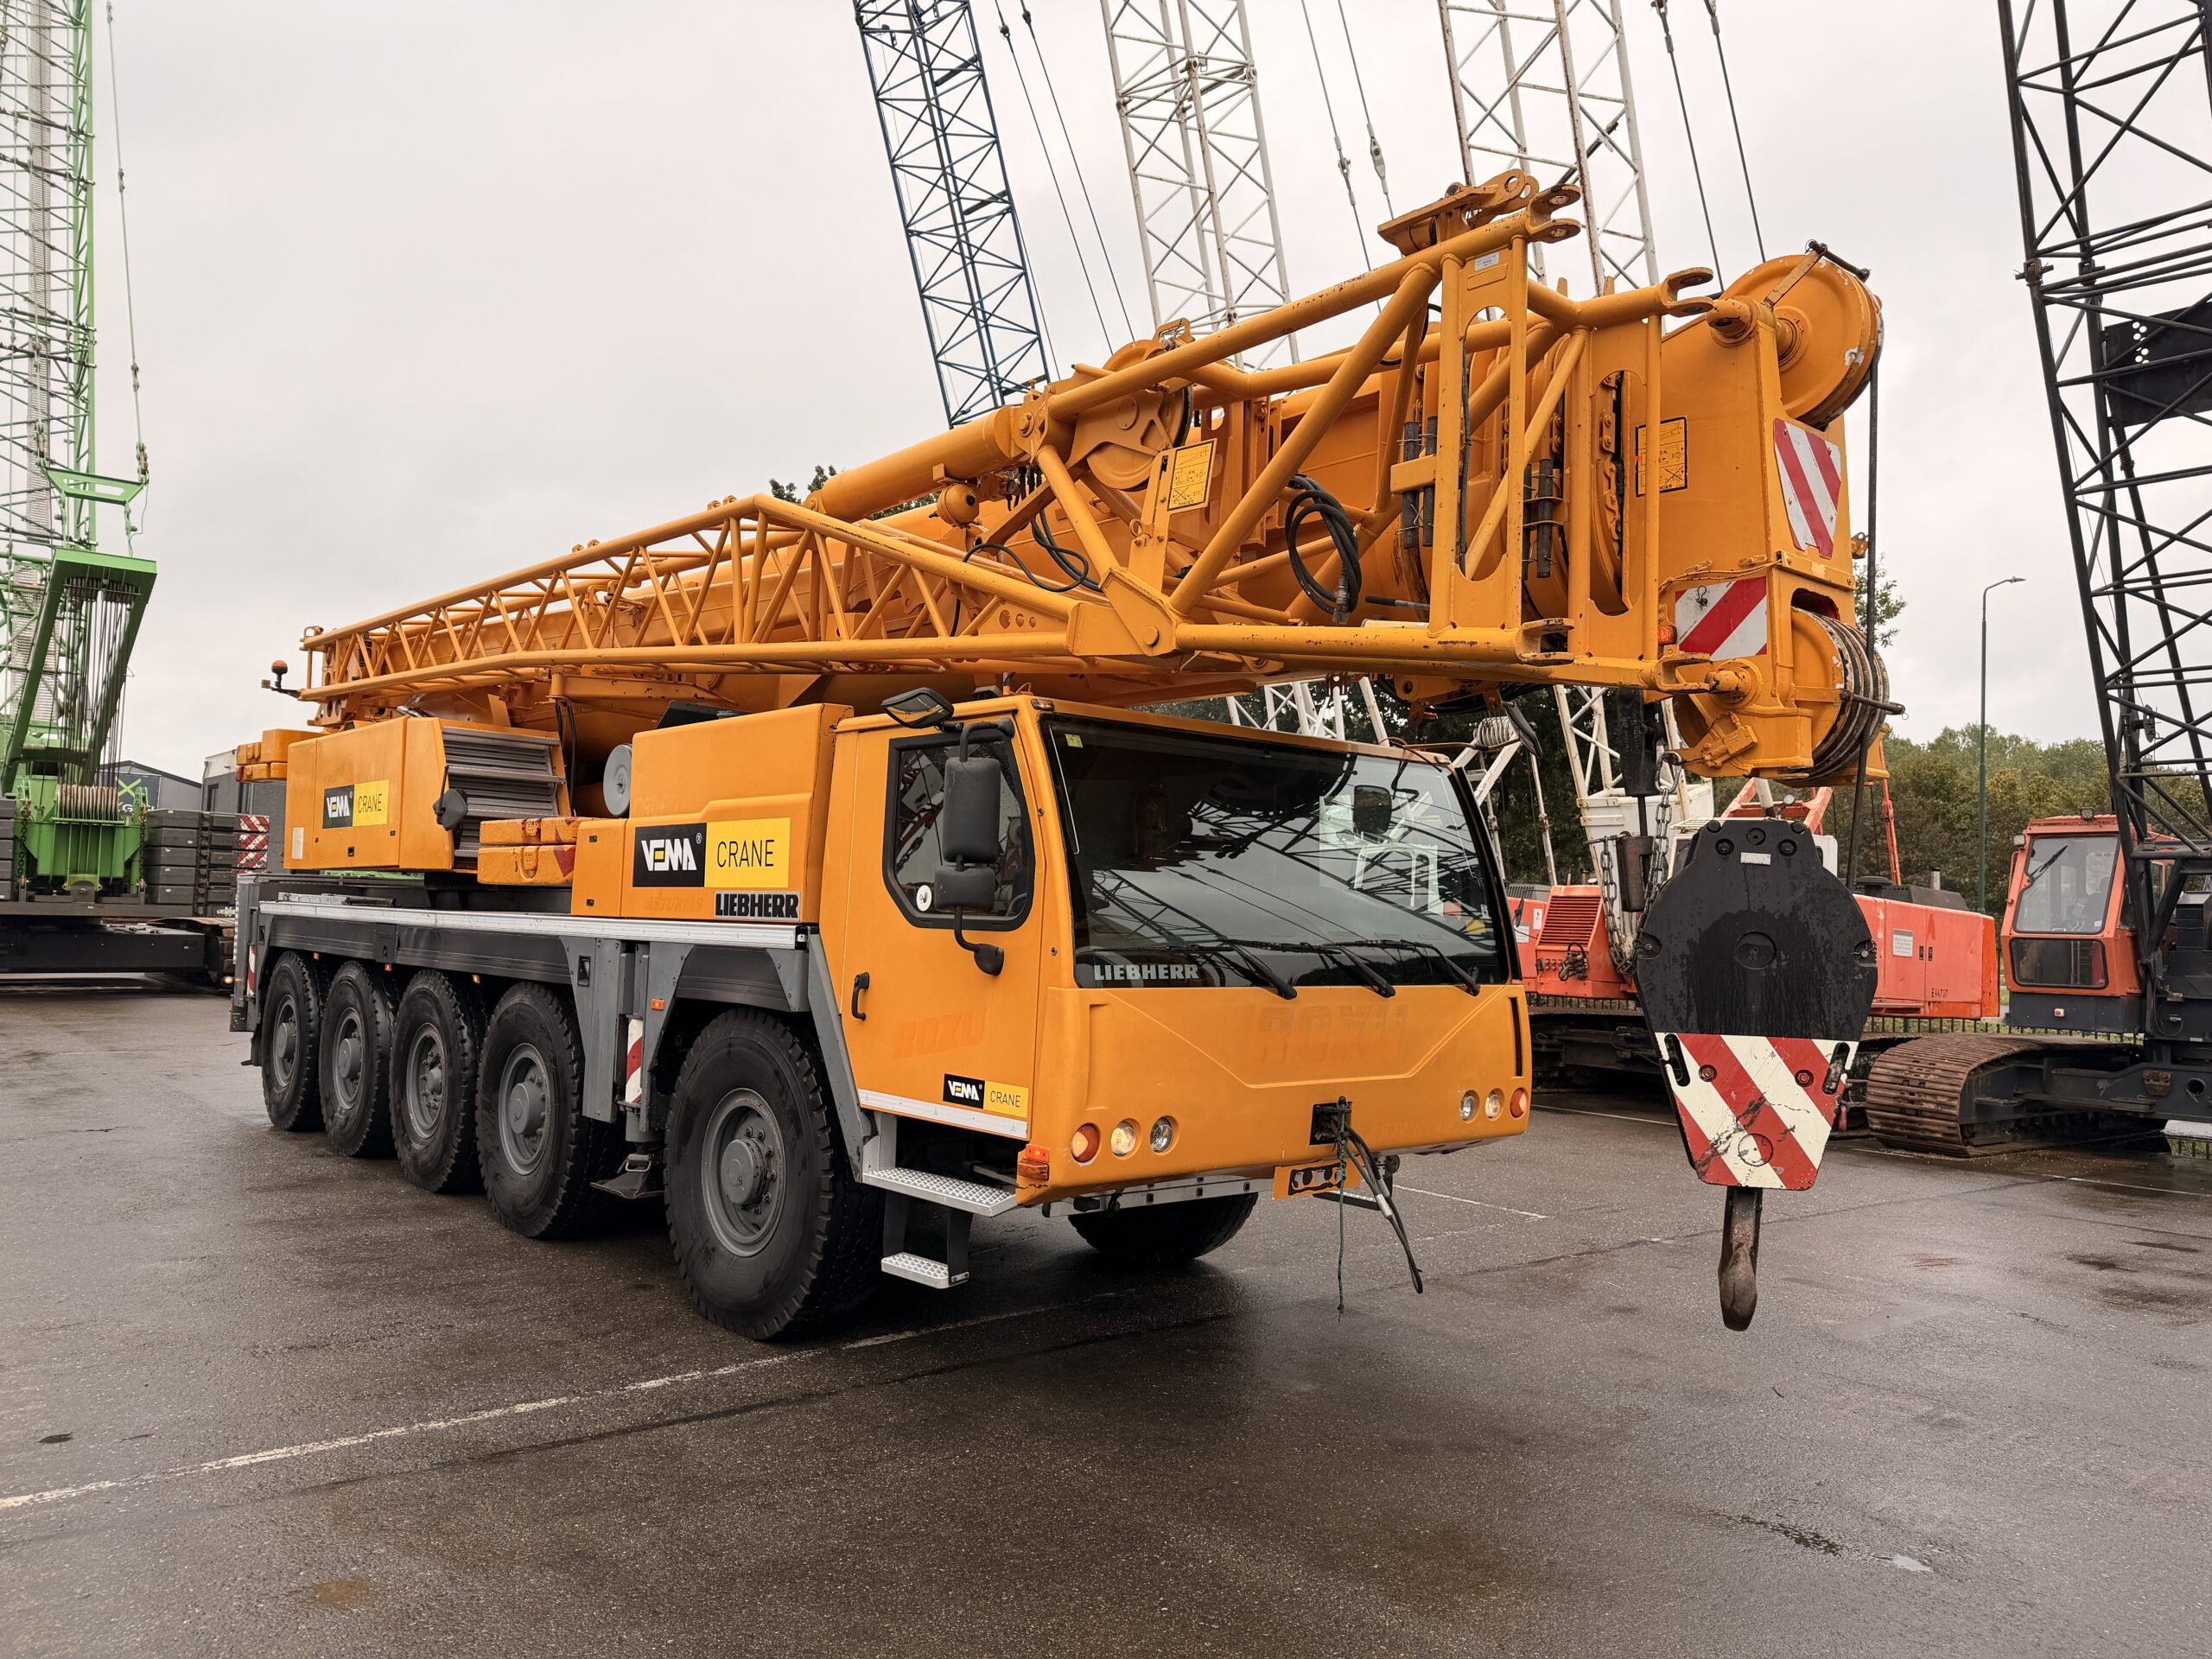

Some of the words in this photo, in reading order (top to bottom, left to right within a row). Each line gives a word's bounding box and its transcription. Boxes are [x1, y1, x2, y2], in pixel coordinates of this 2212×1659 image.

[327, 795, 350, 818] VEMA
[358, 793, 383, 813] CRANE
[641, 837, 697, 872] VEMA
[716, 839, 775, 868] CRANE
[715, 893, 799, 918] LIEBHERR
[1094, 963, 1199, 981] LIEBHERR
[948, 1080, 980, 1101] VEMA
[990, 1090, 1021, 1108] CRANE
